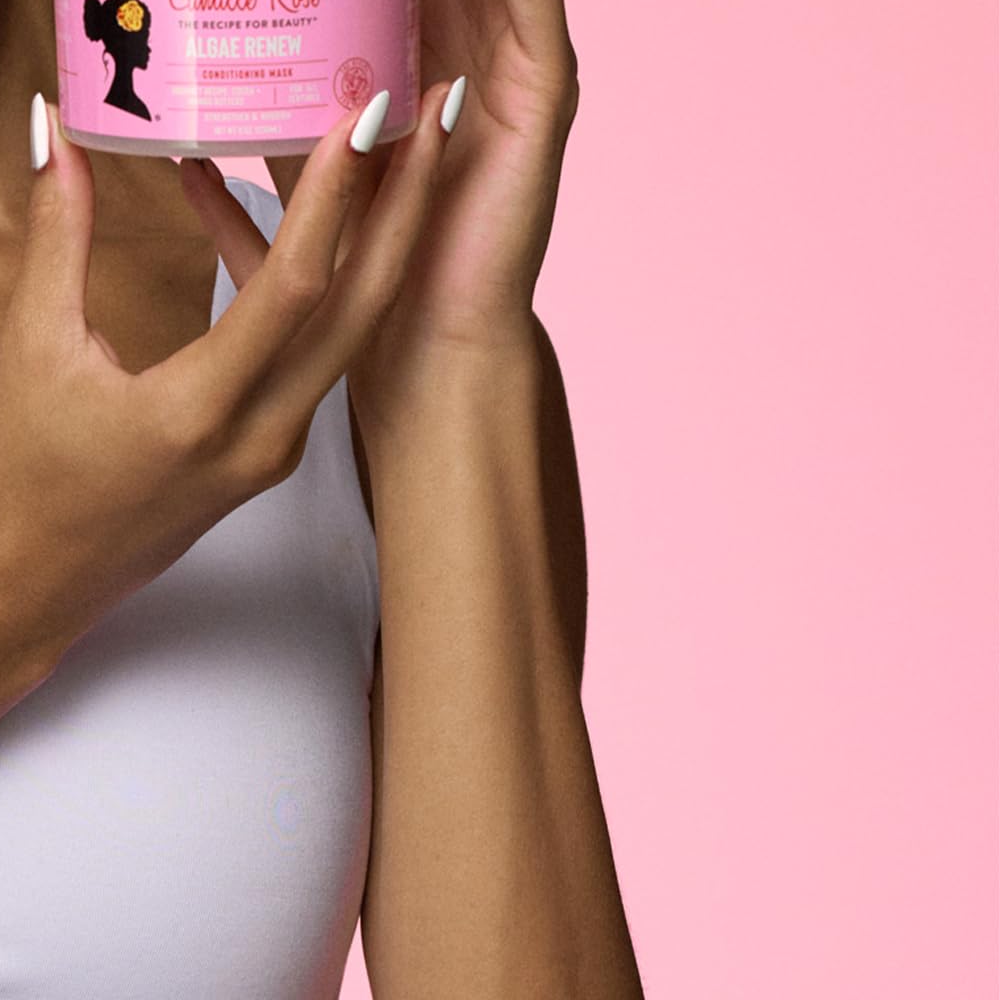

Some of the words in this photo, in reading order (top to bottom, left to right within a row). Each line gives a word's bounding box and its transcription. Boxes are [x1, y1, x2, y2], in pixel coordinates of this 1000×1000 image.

[178, 20, 199, 29] THE
[202, 19, 242, 30] RECIPE
[245, 18, 269, 29] FOR
[185, 35, 242, 59] ALGAE
[243, 34, 303, 58] RENEW
[201, 68, 266, 80] CONDITIONING
[268, 67, 294, 78] MASK
